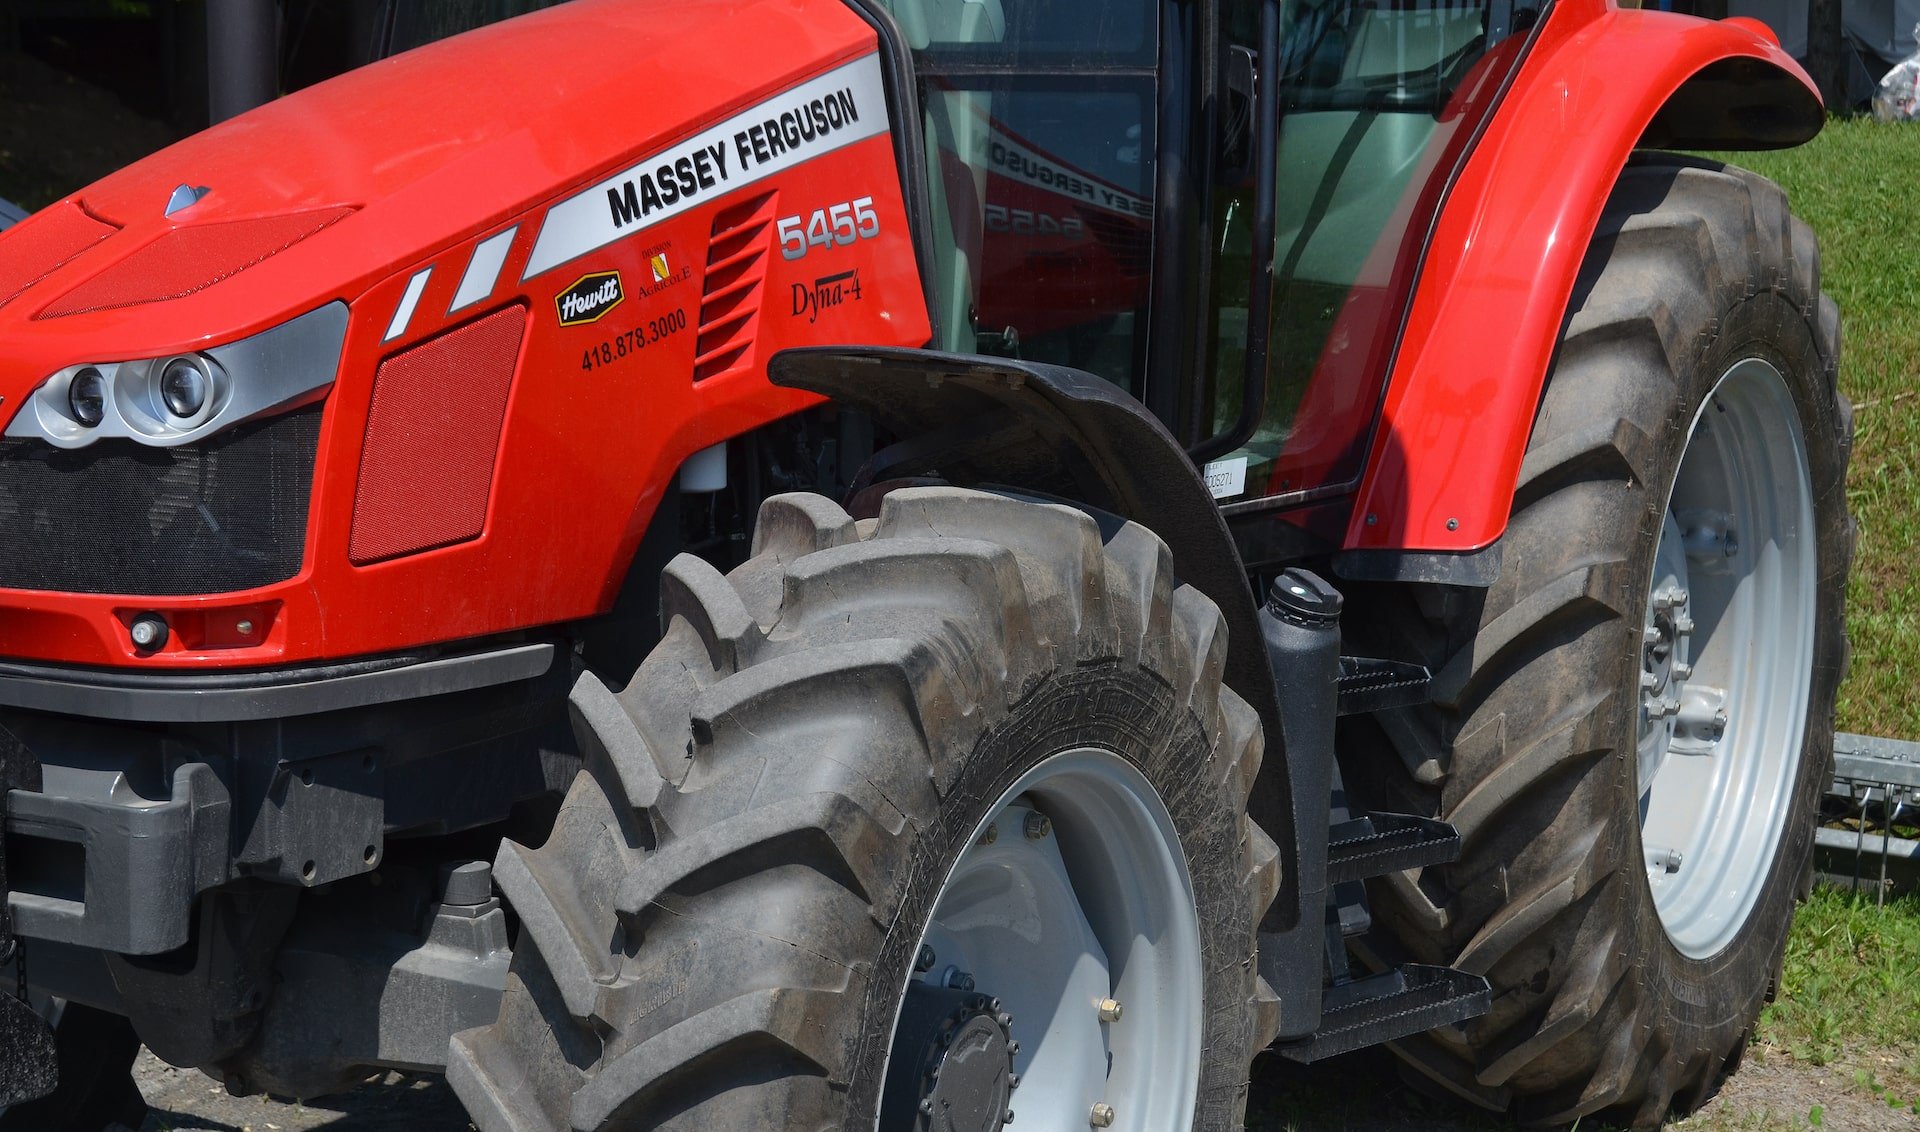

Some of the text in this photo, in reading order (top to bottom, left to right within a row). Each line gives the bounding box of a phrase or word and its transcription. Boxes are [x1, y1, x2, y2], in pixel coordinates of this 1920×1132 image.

[607, 87, 859, 228] MASSEY FERGUSON
[641, 240, 672, 260] DIVISION
[776, 196, 880, 261] 5455
[562, 278, 618, 320] Hewitt
[639, 265, 692, 300] AGRICOLE
[791, 267, 862, 324] Dyna-4
[582, 308, 686, 371] 418.878.3000
